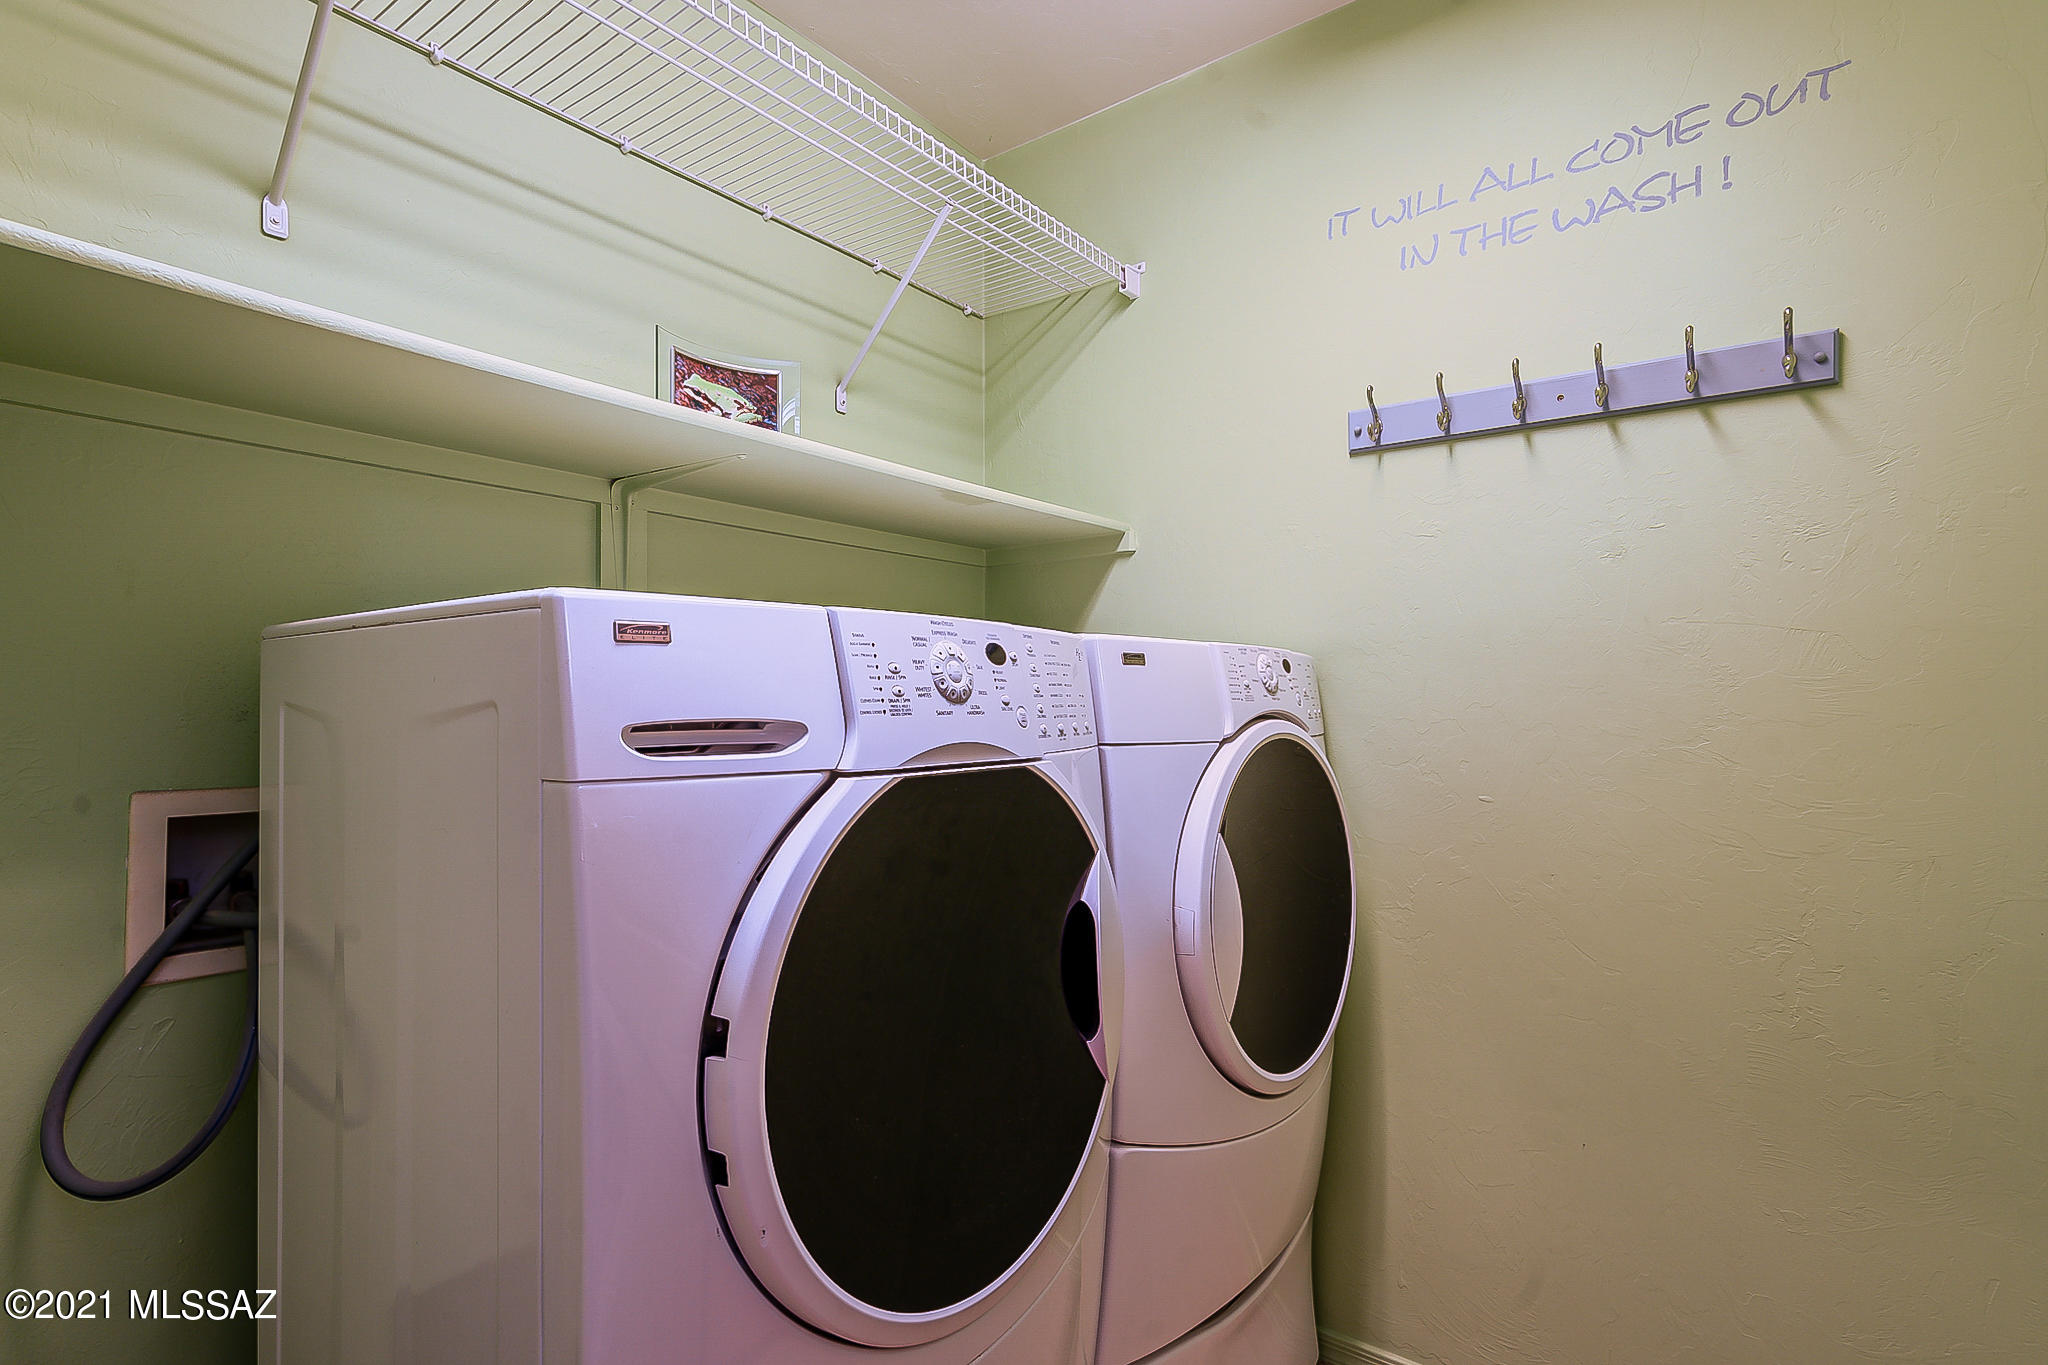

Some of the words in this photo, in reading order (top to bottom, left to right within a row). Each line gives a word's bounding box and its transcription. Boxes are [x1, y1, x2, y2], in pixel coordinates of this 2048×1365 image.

[1327, 206, 1362, 241] IT
[1370, 183, 1458, 229] WILL
[1469, 156, 1555, 202] ALL
[1565, 102, 1711, 175] COME
[1724, 59, 1852, 128] OUT
[1399, 231, 1440, 271] IN
[1450, 208, 1540, 257] THE
